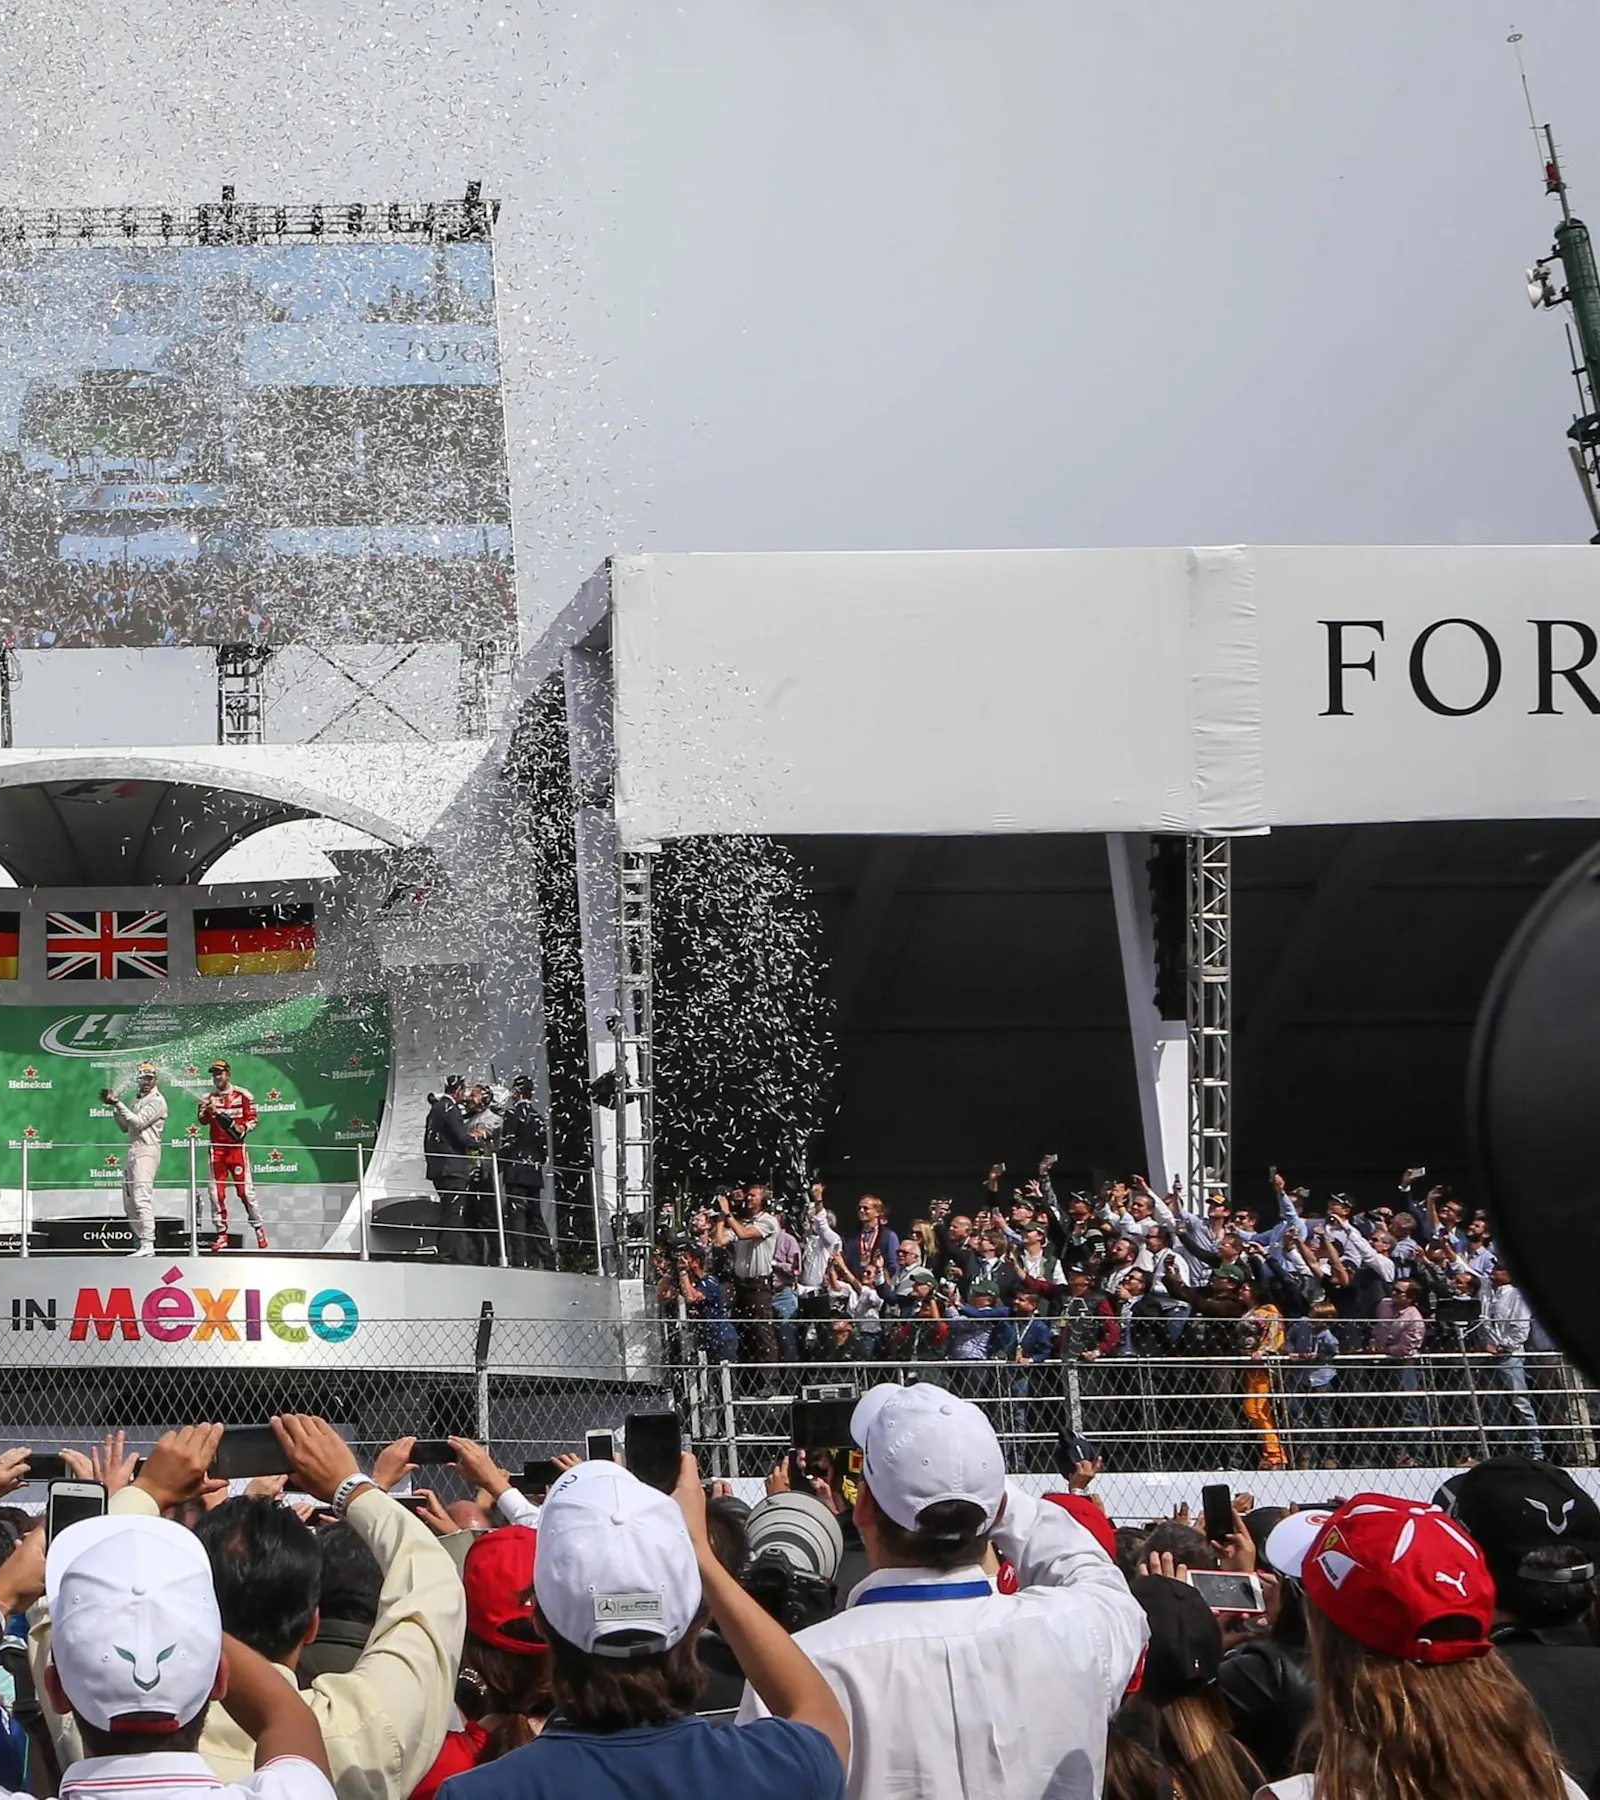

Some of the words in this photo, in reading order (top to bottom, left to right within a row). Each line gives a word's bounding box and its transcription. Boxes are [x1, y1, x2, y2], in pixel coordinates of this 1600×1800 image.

[1317, 618, 1600, 716] FOR
[332, 1068, 376, 1080] Heineken
[8, 1079, 53, 1090] Heineken
[171, 1077, 214, 1088] Heineken
[253, 1161, 298, 1174] Heineken
[89, 1168, 124, 1179] Heinek
[83, 1231, 134, 1241] CHANDO
[11, 1297, 59, 1332] IN
